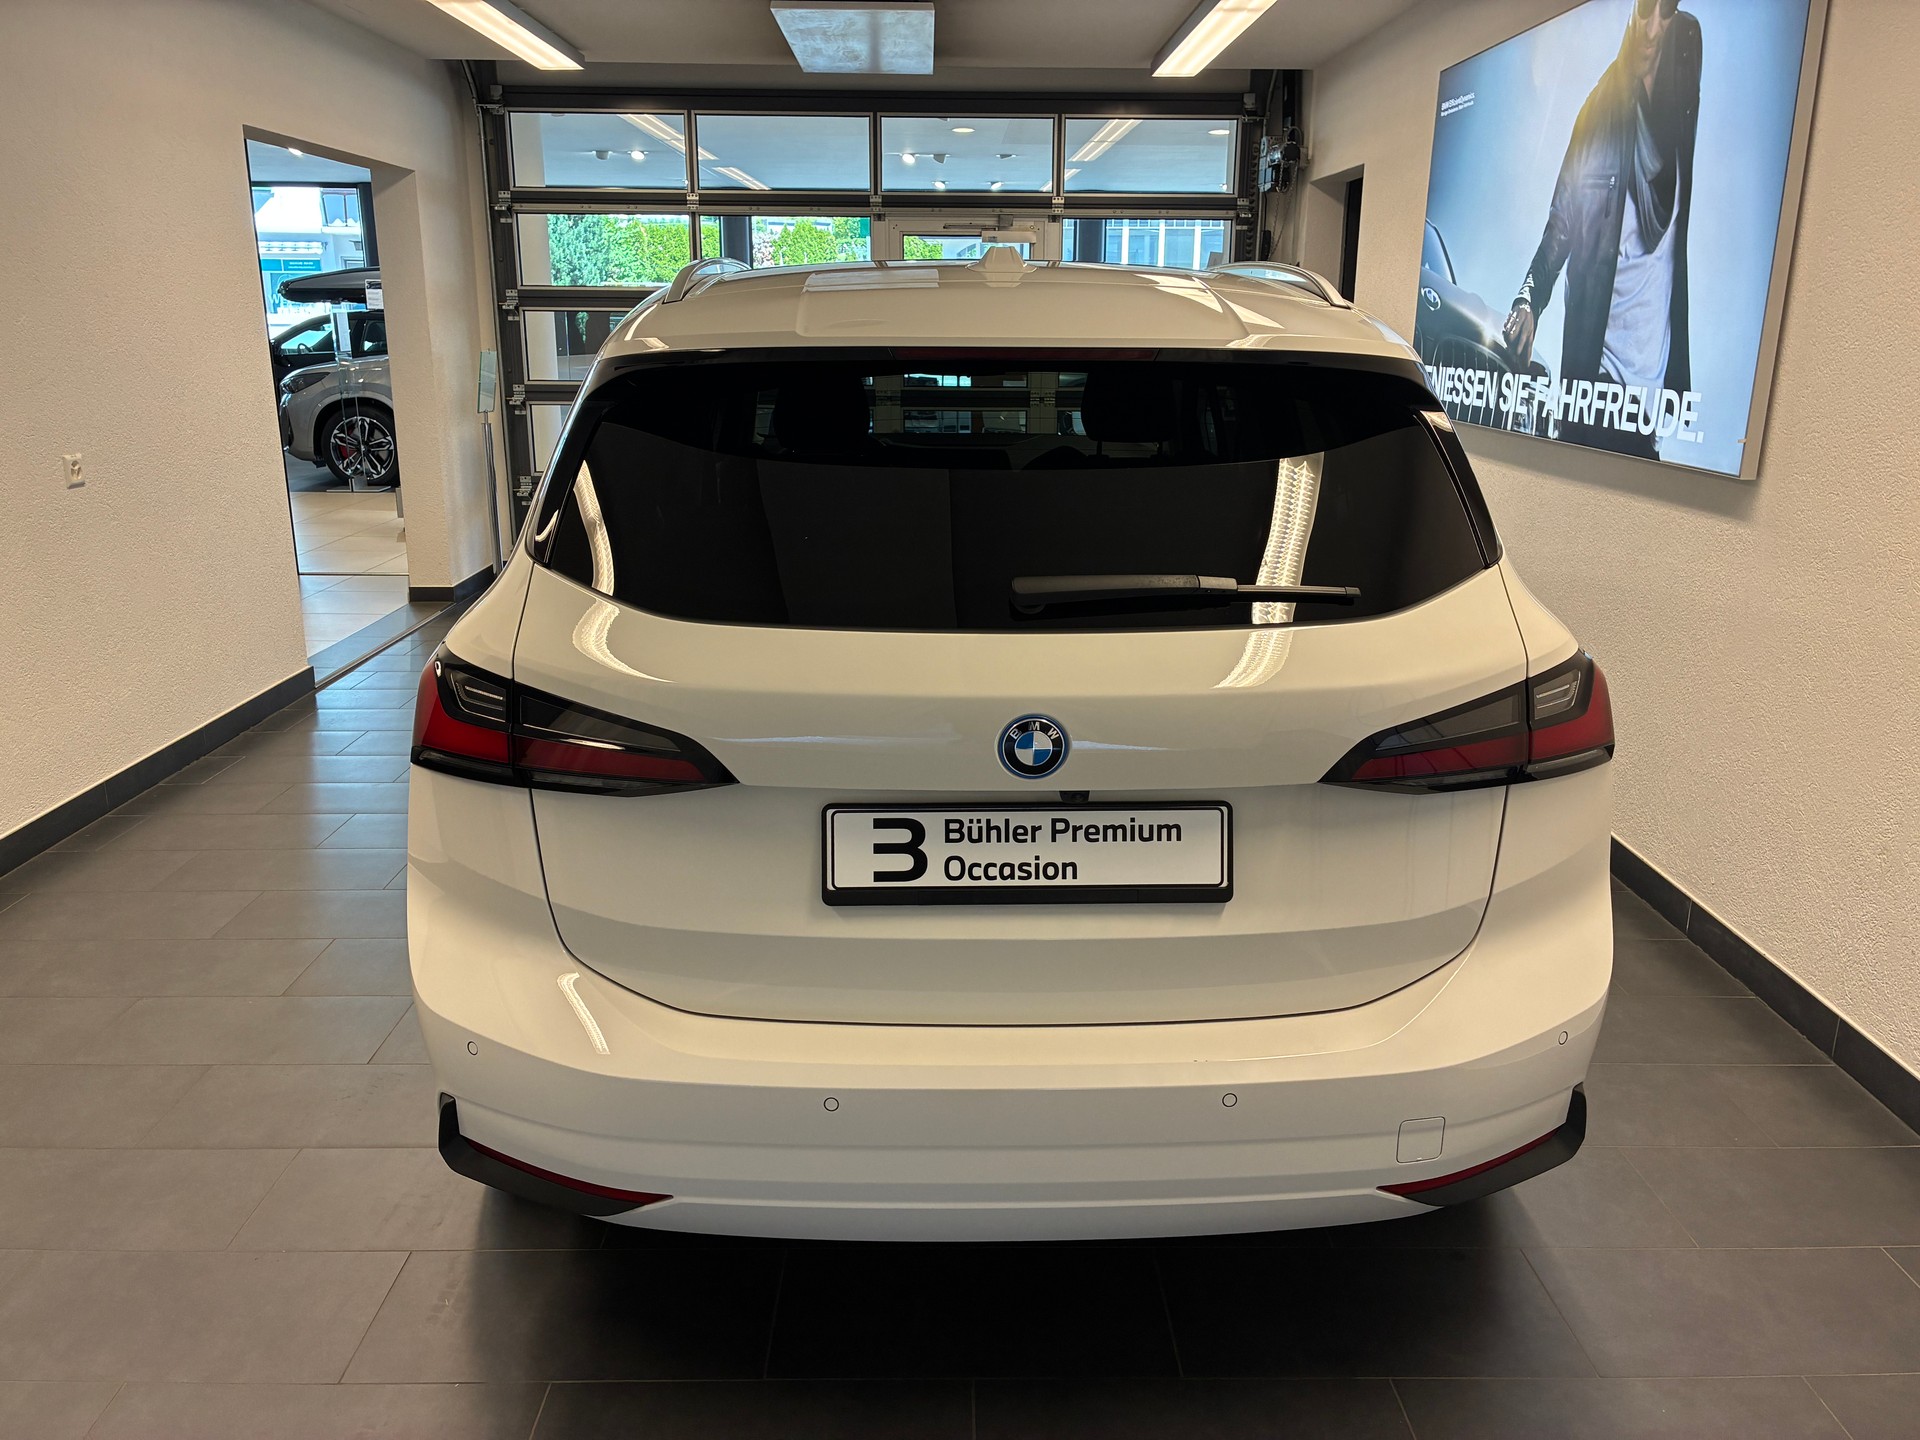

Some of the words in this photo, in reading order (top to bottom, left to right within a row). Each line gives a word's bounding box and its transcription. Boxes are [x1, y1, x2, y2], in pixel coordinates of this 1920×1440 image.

[1499, 372, 1532, 415] SIE
[1533, 376, 1704, 443] FAHRFREUDE.
[1009, 721, 1060, 740] BMW
[944, 818, 1042, 843] Bühler
[1050, 817, 1182, 842] Premium
[944, 855, 1078, 881] Occasion
